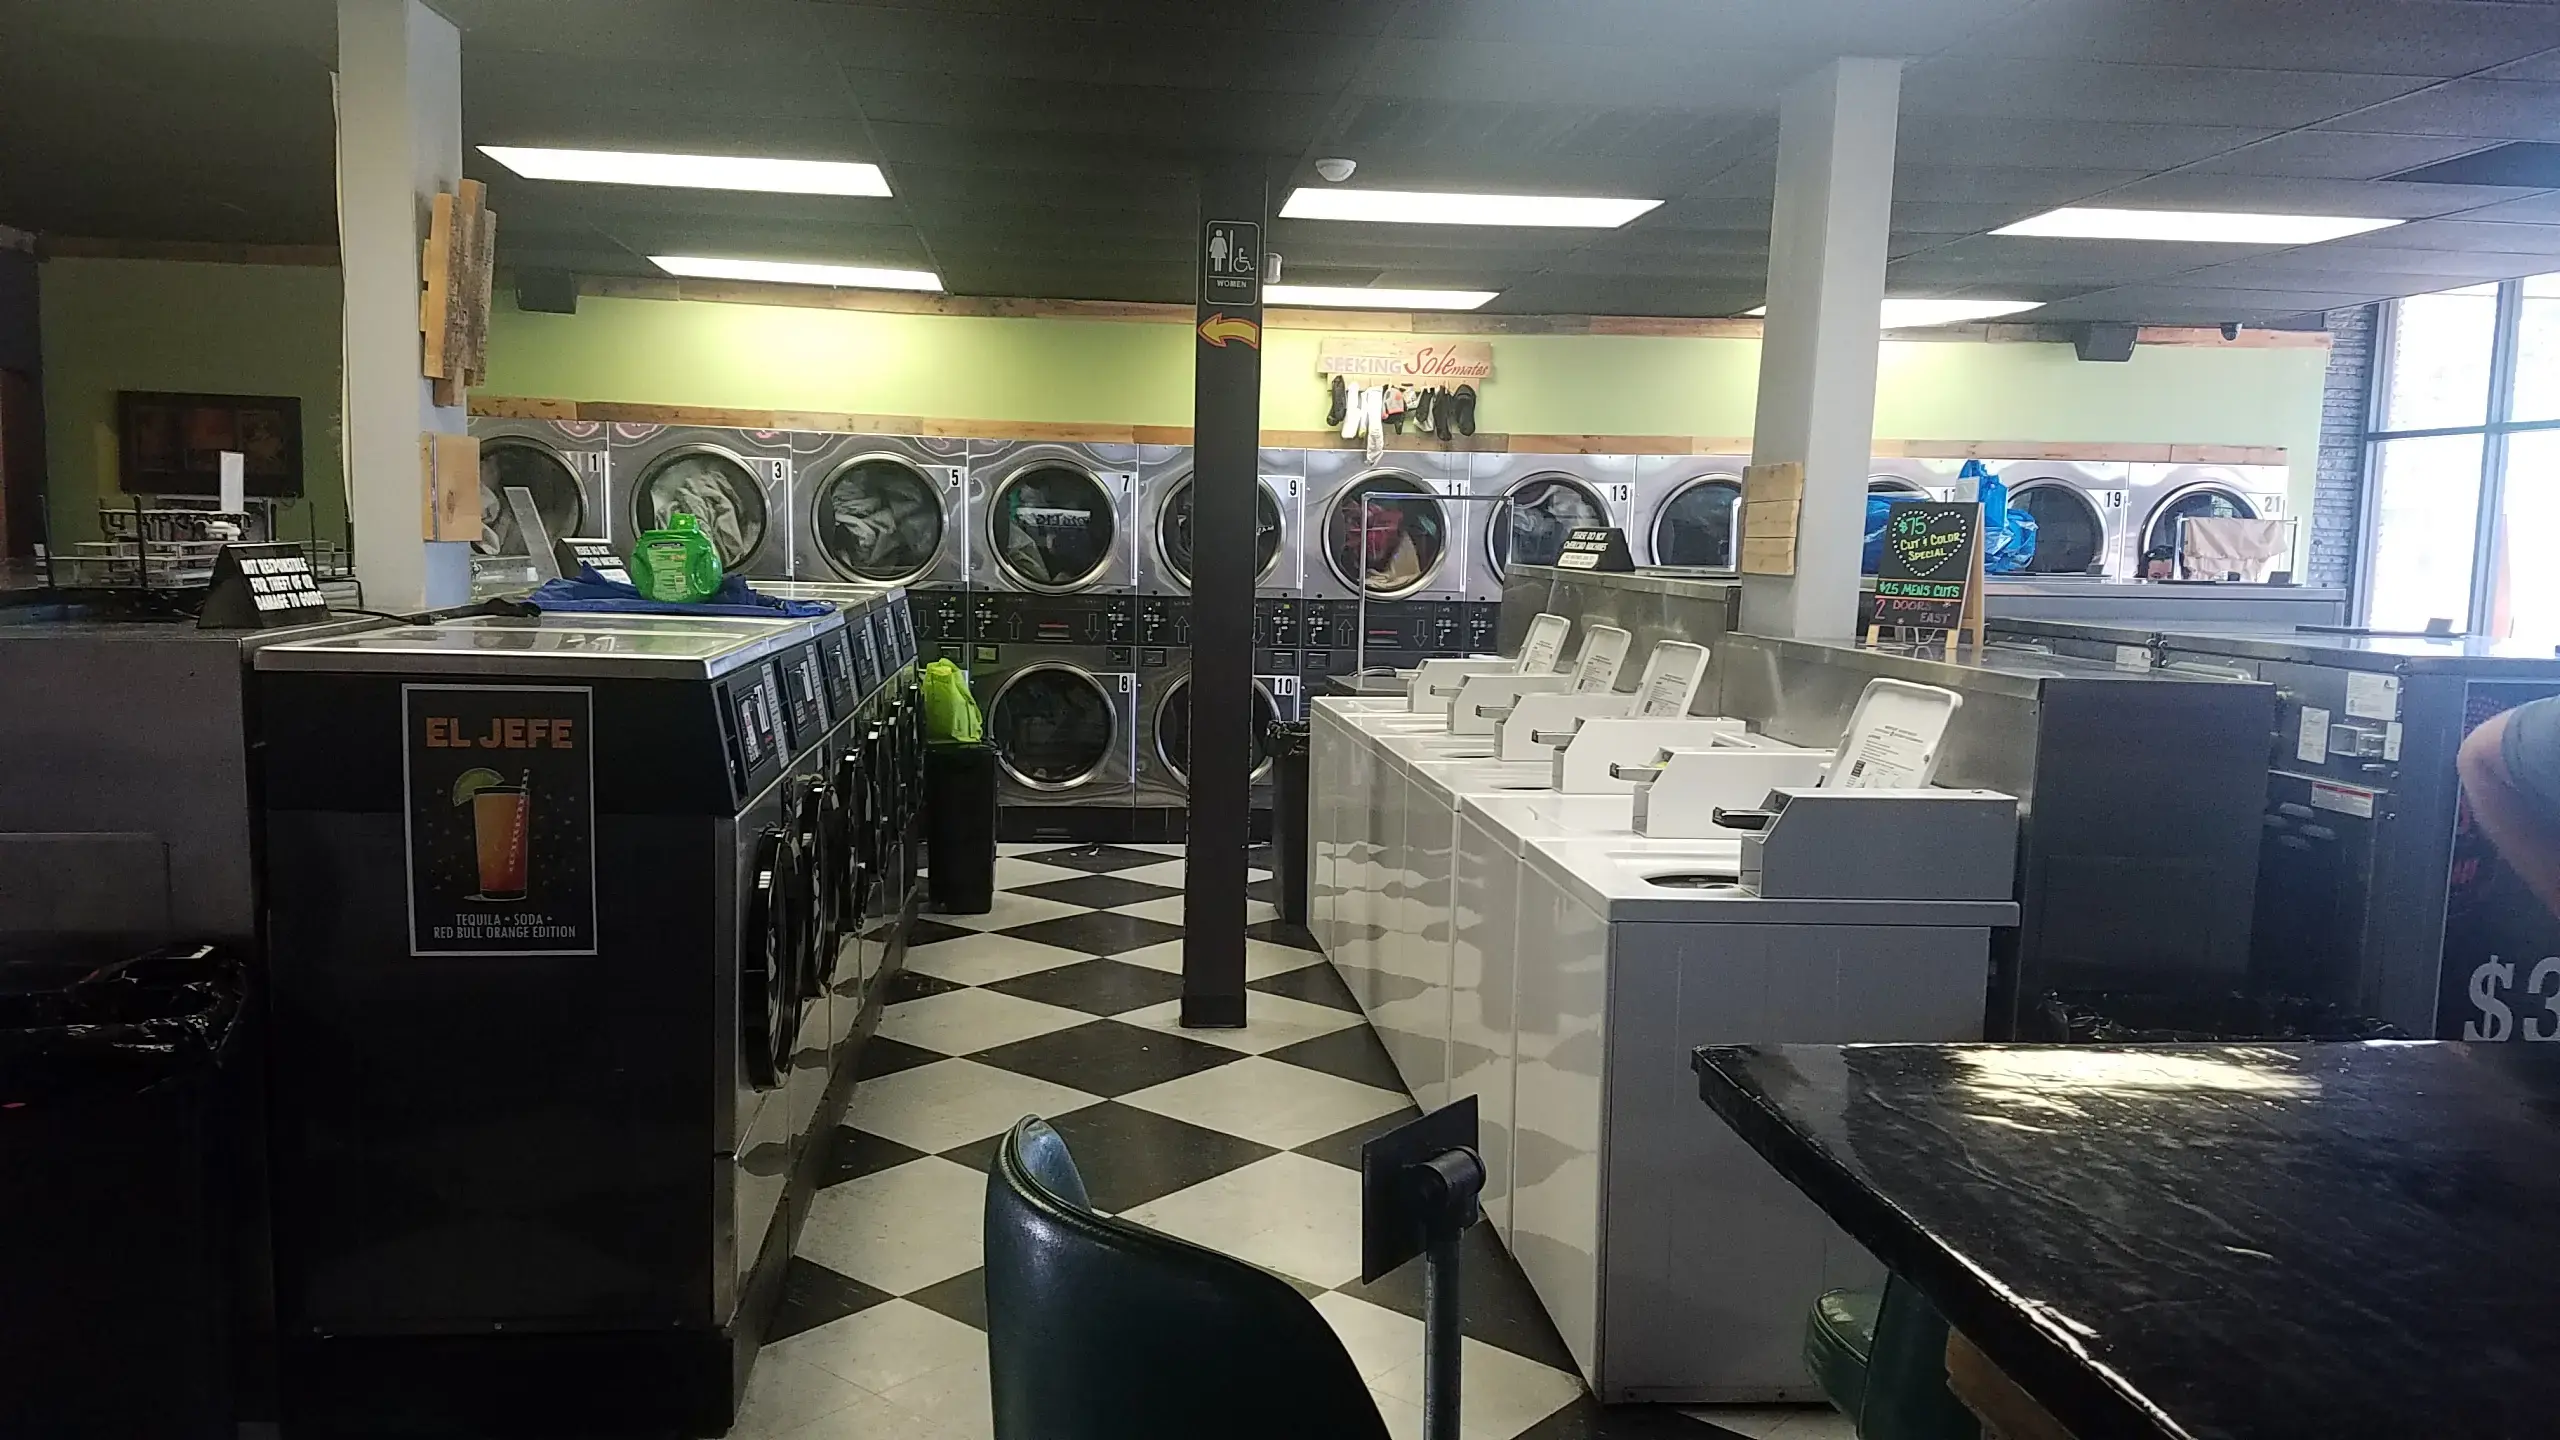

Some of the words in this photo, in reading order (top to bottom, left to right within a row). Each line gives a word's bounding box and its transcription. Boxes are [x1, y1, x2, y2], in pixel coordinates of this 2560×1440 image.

[1216, 280, 1247, 288] WOMEN
[1324, 356, 1401, 374] SEEKING
[591, 453, 597, 471] 1
[774, 461, 782, 478] 3
[951, 469, 959, 486] 5
[1122, 475, 1130, 491] 7
[1289, 479, 1297, 496] 9
[1447, 483, 1462, 496] 11
[1612, 485, 1628, 501] 13
[2106, 491, 2122, 507] 19
[2264, 495, 2282, 512] 21
[1898, 516, 1927, 536] $75
[1900, 538, 1919, 551] CUT
[1930, 532, 1960, 546] COLOR
[1908, 548, 1947, 562] SPECIAL
[1879, 581, 1899, 595] $25
[1901, 582, 1931, 596] MENS
[1933, 584, 1960, 598] CUTS
[1874, 599, 1886, 620] 2
[1892, 600, 1932, 610] DOORS
[1920, 612, 1951, 624] EAST
[1120, 675, 1129, 692] 8
[1277, 677, 1293, 694] 10
[425, 717, 471, 747] EL
[479, 718, 573, 748] JEFE
[456, 913, 501, 926] TEQUILA
[514, 913, 543, 925] SODA
[434, 926, 454, 939] RED
[457, 926, 483, 938] BULL
[486, 926, 530, 938] ORANGE
[532, 925, 576, 938] EDITION
